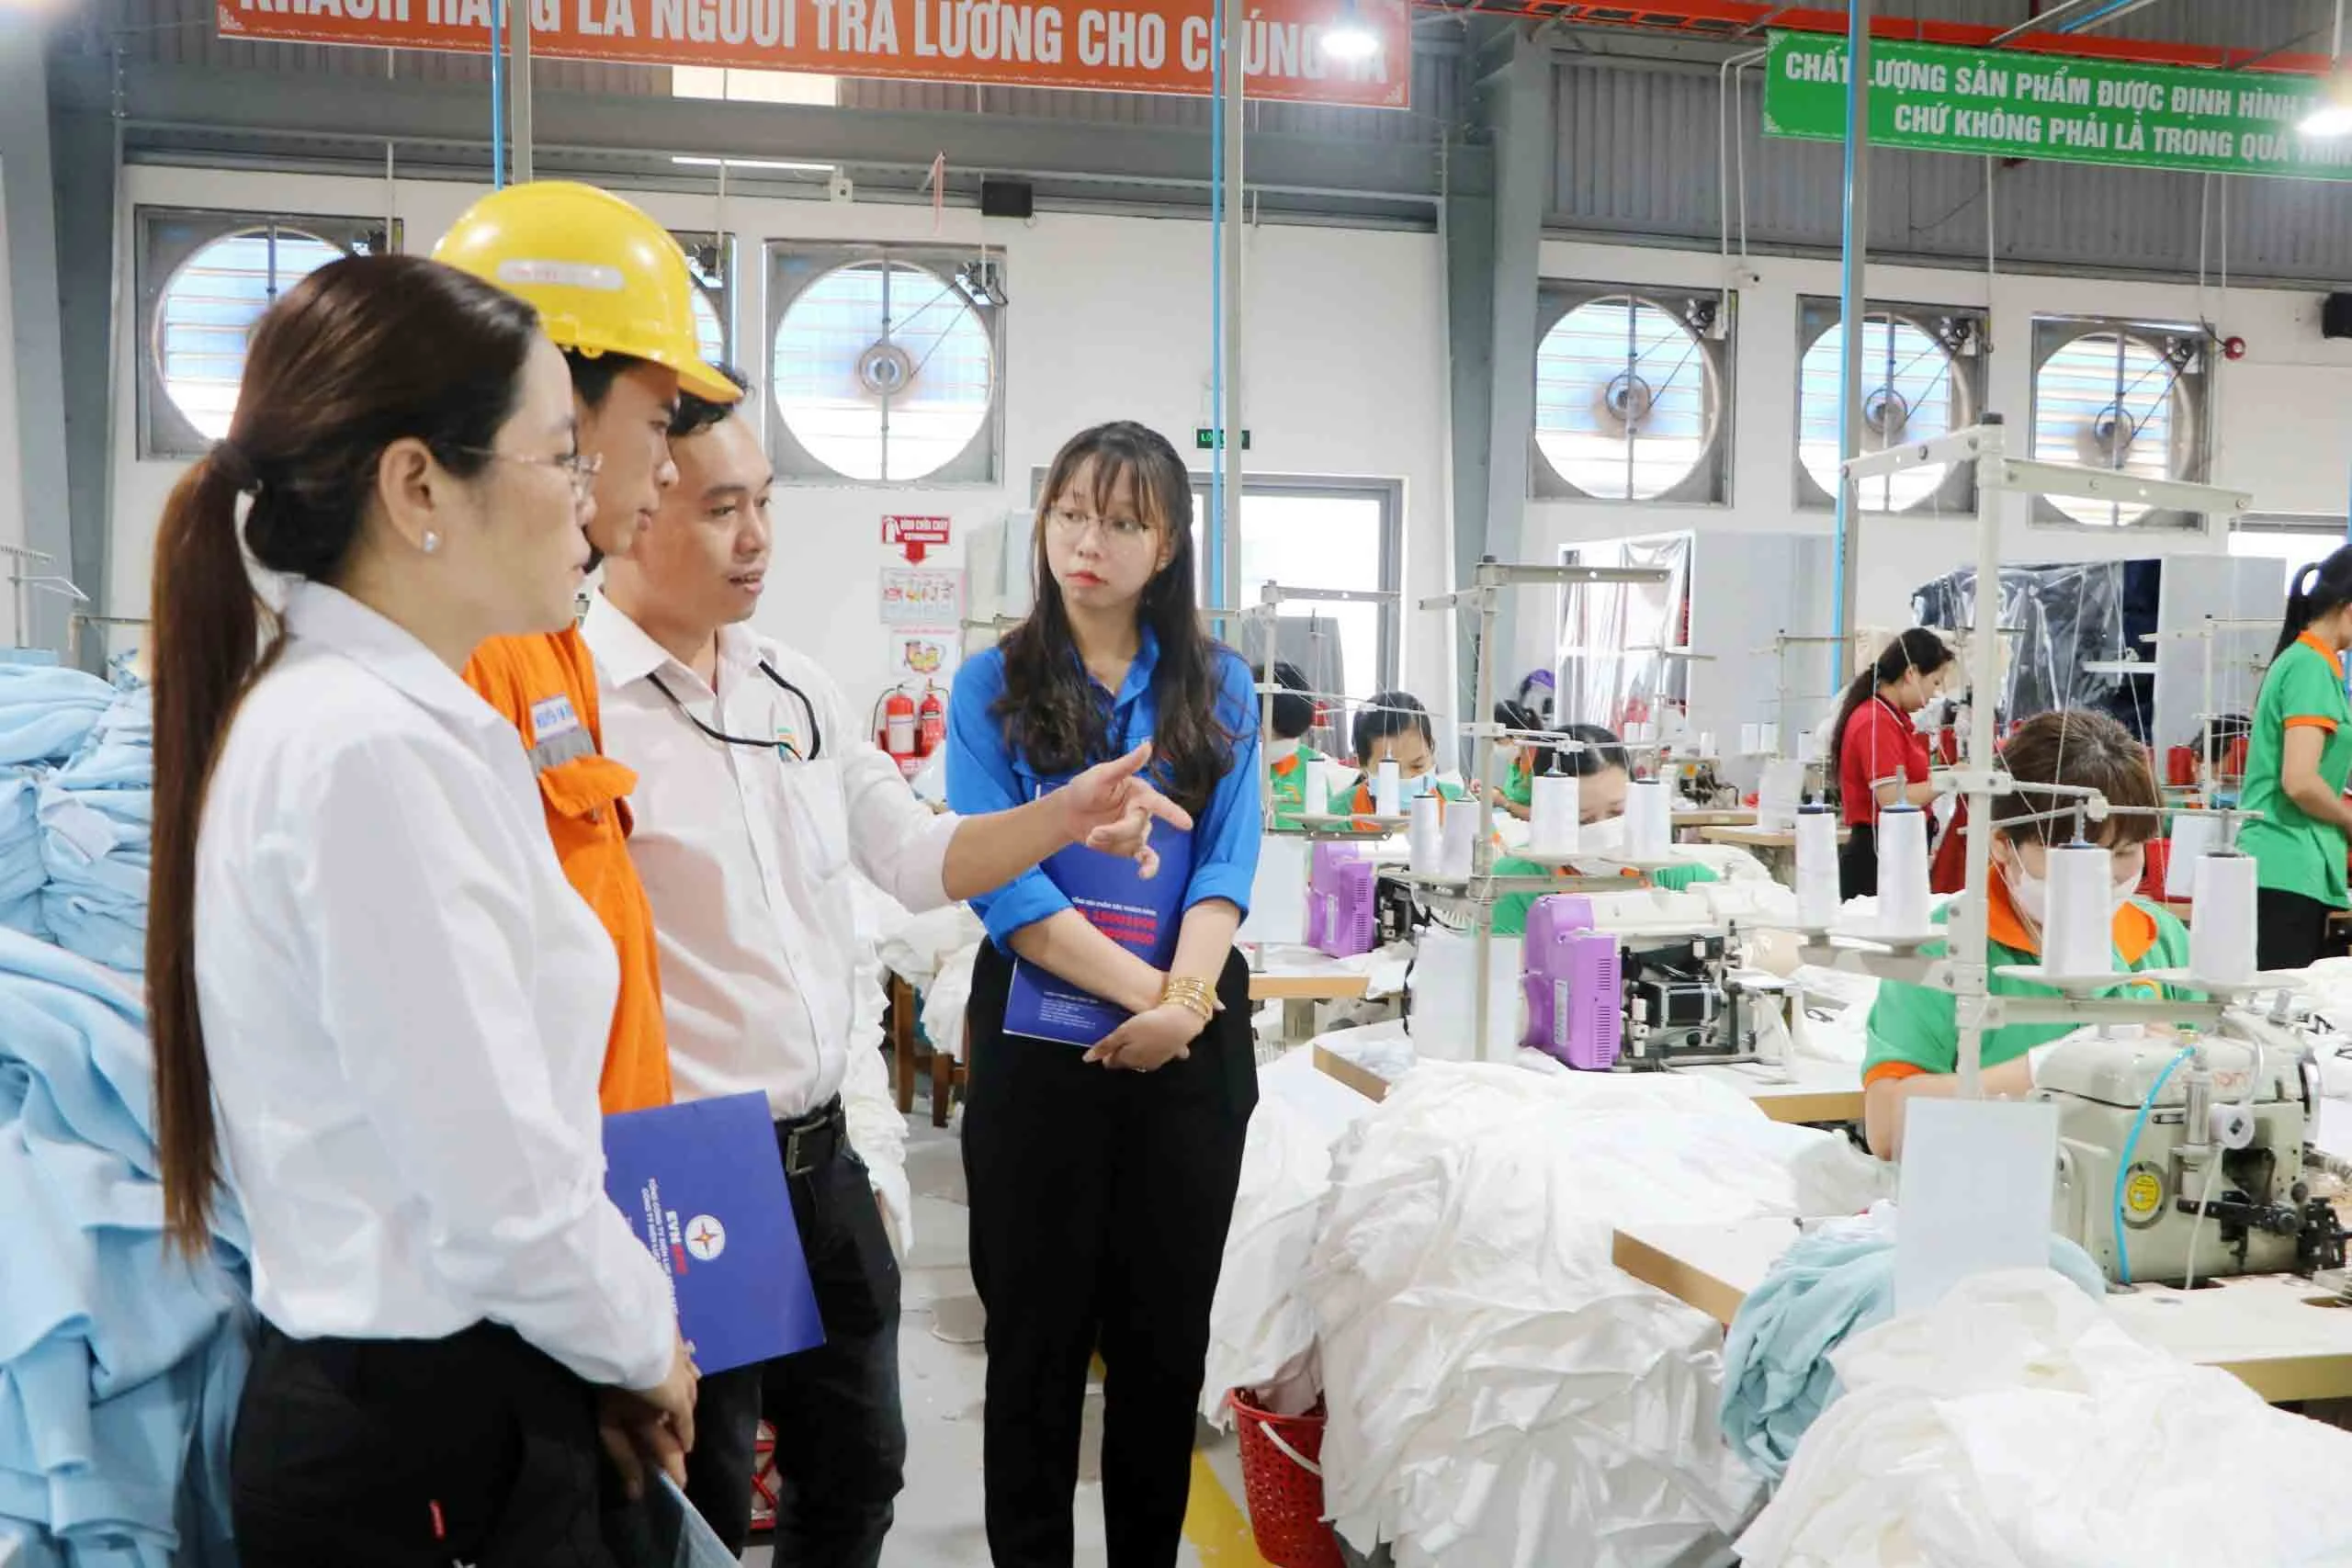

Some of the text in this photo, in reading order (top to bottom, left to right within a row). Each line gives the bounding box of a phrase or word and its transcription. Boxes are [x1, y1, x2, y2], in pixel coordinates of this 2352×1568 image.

[1078, 8, 1166, 70] CHO
[1868, 58, 1948, 95] ƯỢNG
[1955, 60, 2007, 98] SẢN
[2016, 65, 2090, 105] PHẨM
[2097, 79, 2165, 116] ĐƯỢC
[2171, 85, 2231, 119] ĐỊNH
[2237, 87, 2298, 121] HÌNH
[1894, 102, 1951, 134] CHỨ
[1954, 107, 2042, 143] KHÔNG
[2048, 112, 2109, 148] PHẢI
[2154, 127, 2233, 158] TRONG
[2241, 130, 2290, 163] QUÁ
